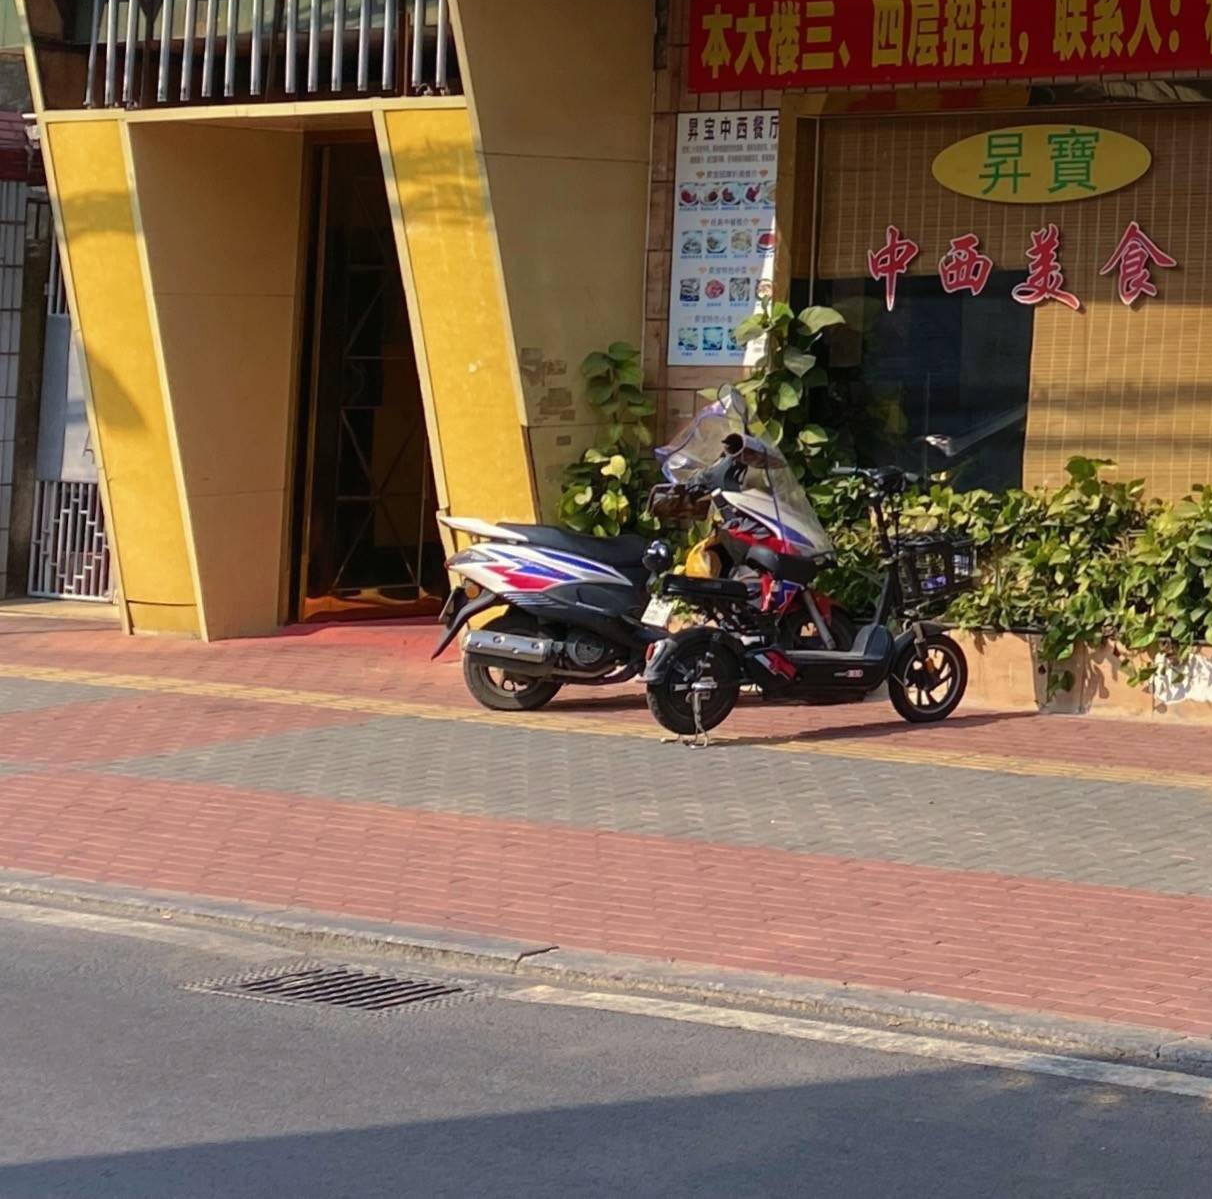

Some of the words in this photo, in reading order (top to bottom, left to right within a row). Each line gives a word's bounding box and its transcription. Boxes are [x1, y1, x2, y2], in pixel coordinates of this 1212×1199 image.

[977, 128, 1101, 195] 昇寶
[867, 220, 1178, 313] 中西美食
